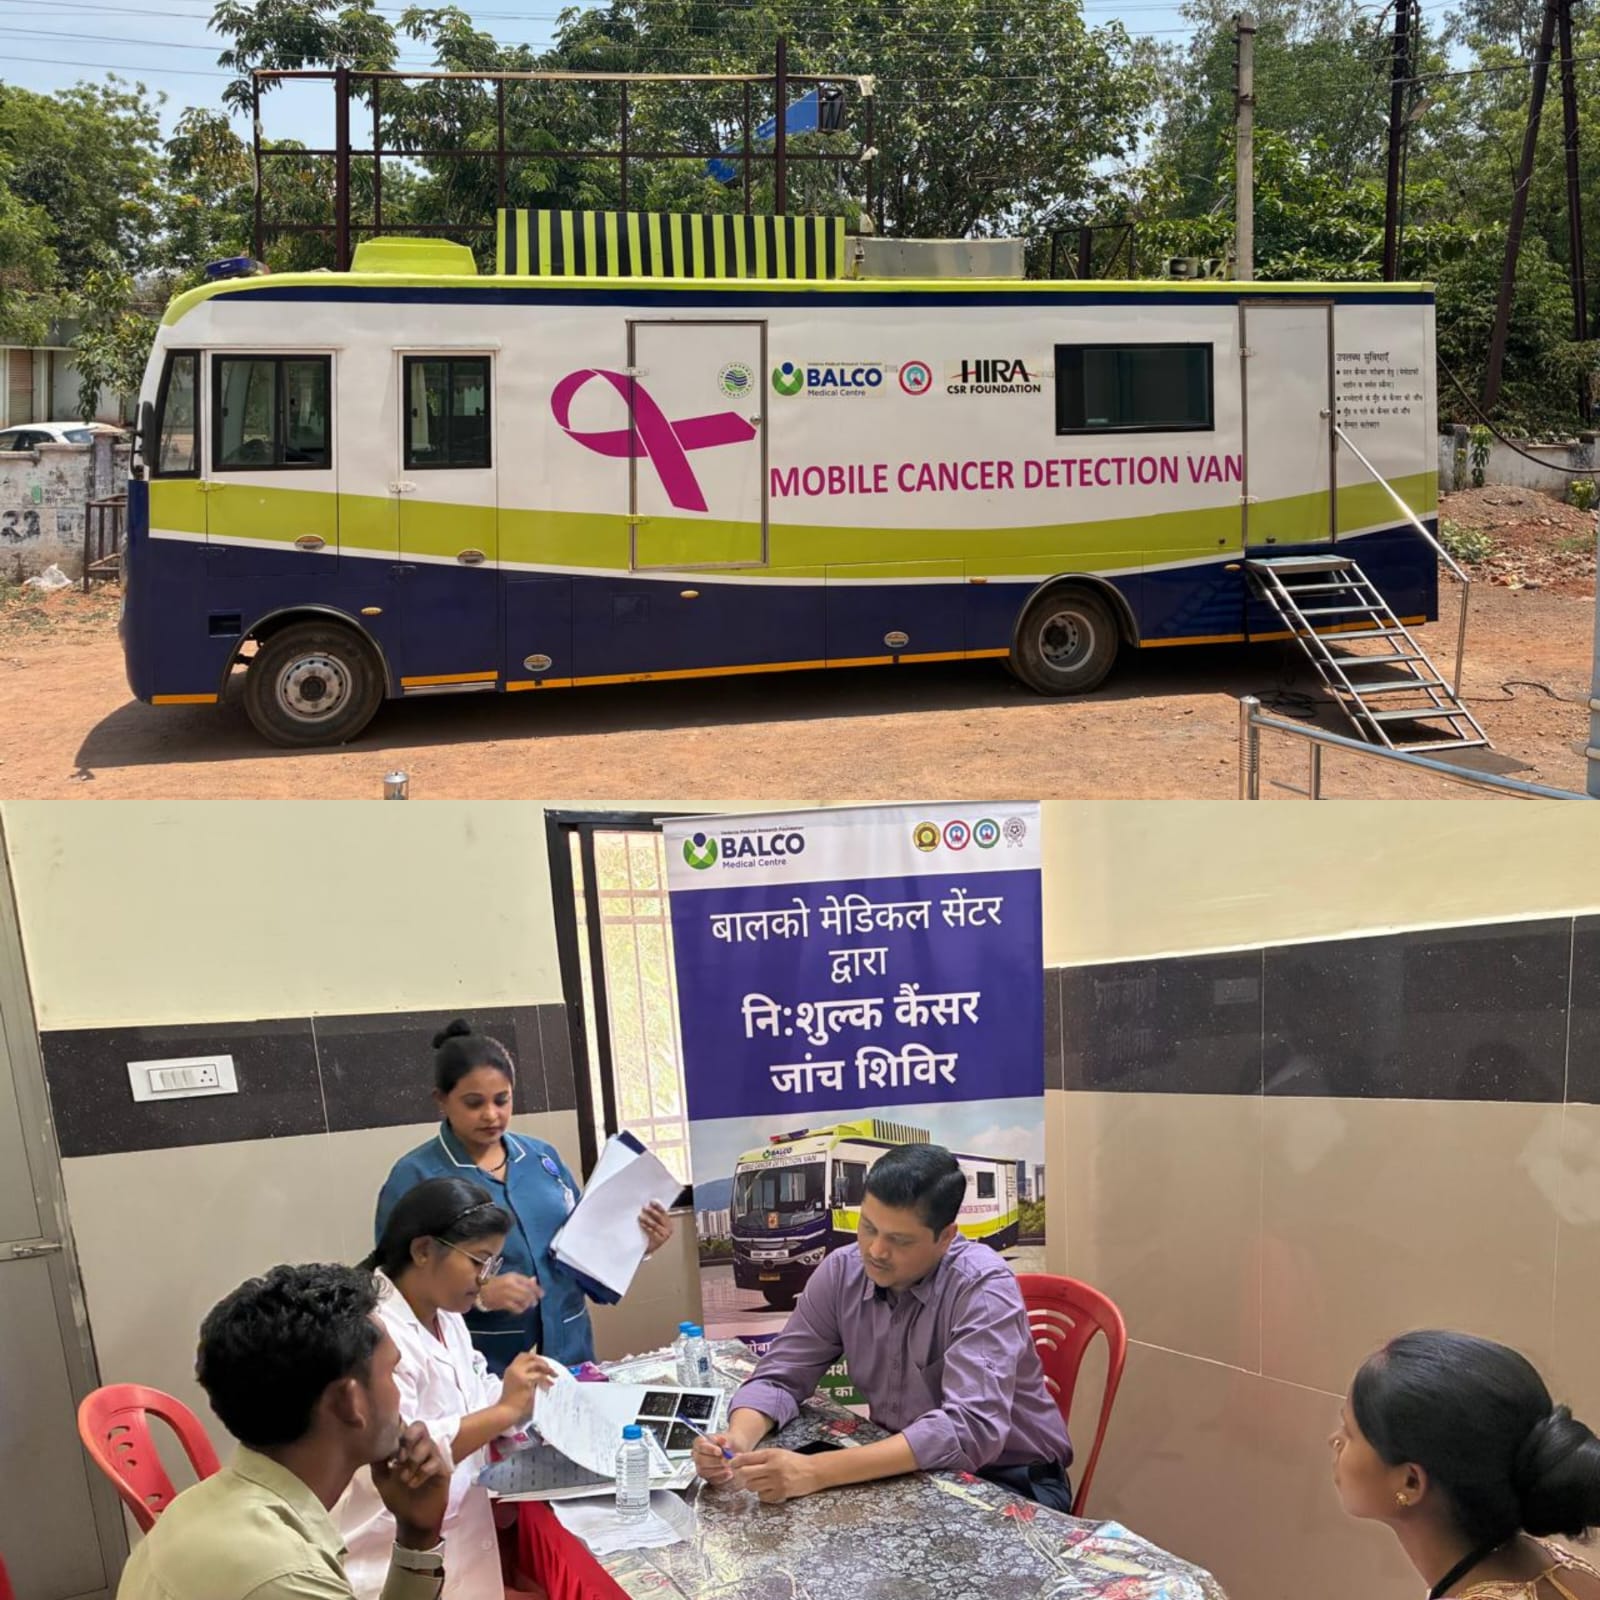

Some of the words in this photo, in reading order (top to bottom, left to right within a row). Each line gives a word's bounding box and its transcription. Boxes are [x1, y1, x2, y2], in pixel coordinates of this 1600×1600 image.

[807, 368, 882, 387] BALCO
[961, 359, 1030, 383] HIRA
[808, 389, 838, 397] Medical
[840, 389, 866, 397] Centre
[947, 385, 967, 394] CSR
[970, 384, 1041, 394] FOUNDATION
[770, 464, 888, 497] MOBILE
[899, 460, 1014, 492] CANCER
[1023, 456, 1178, 489] DETECTION
[1187, 454, 1244, 483] VAN
[721, 833, 805, 859] BALCO
[722, 860, 756, 869] Medical
[758, 858, 787, 867] Centre
[710, 897, 810, 943] बालको
[819, 894, 932, 936] मेडिकल
[940, 887, 1004, 927] सेंटर
[828, 947, 889, 983] द्वारा
[893, 983, 981, 1027] कैंसर
[769, 1053, 846, 1094] जांच
[855, 1043, 959, 1089] शिविर
[834, 1386, 854, 1397] का
